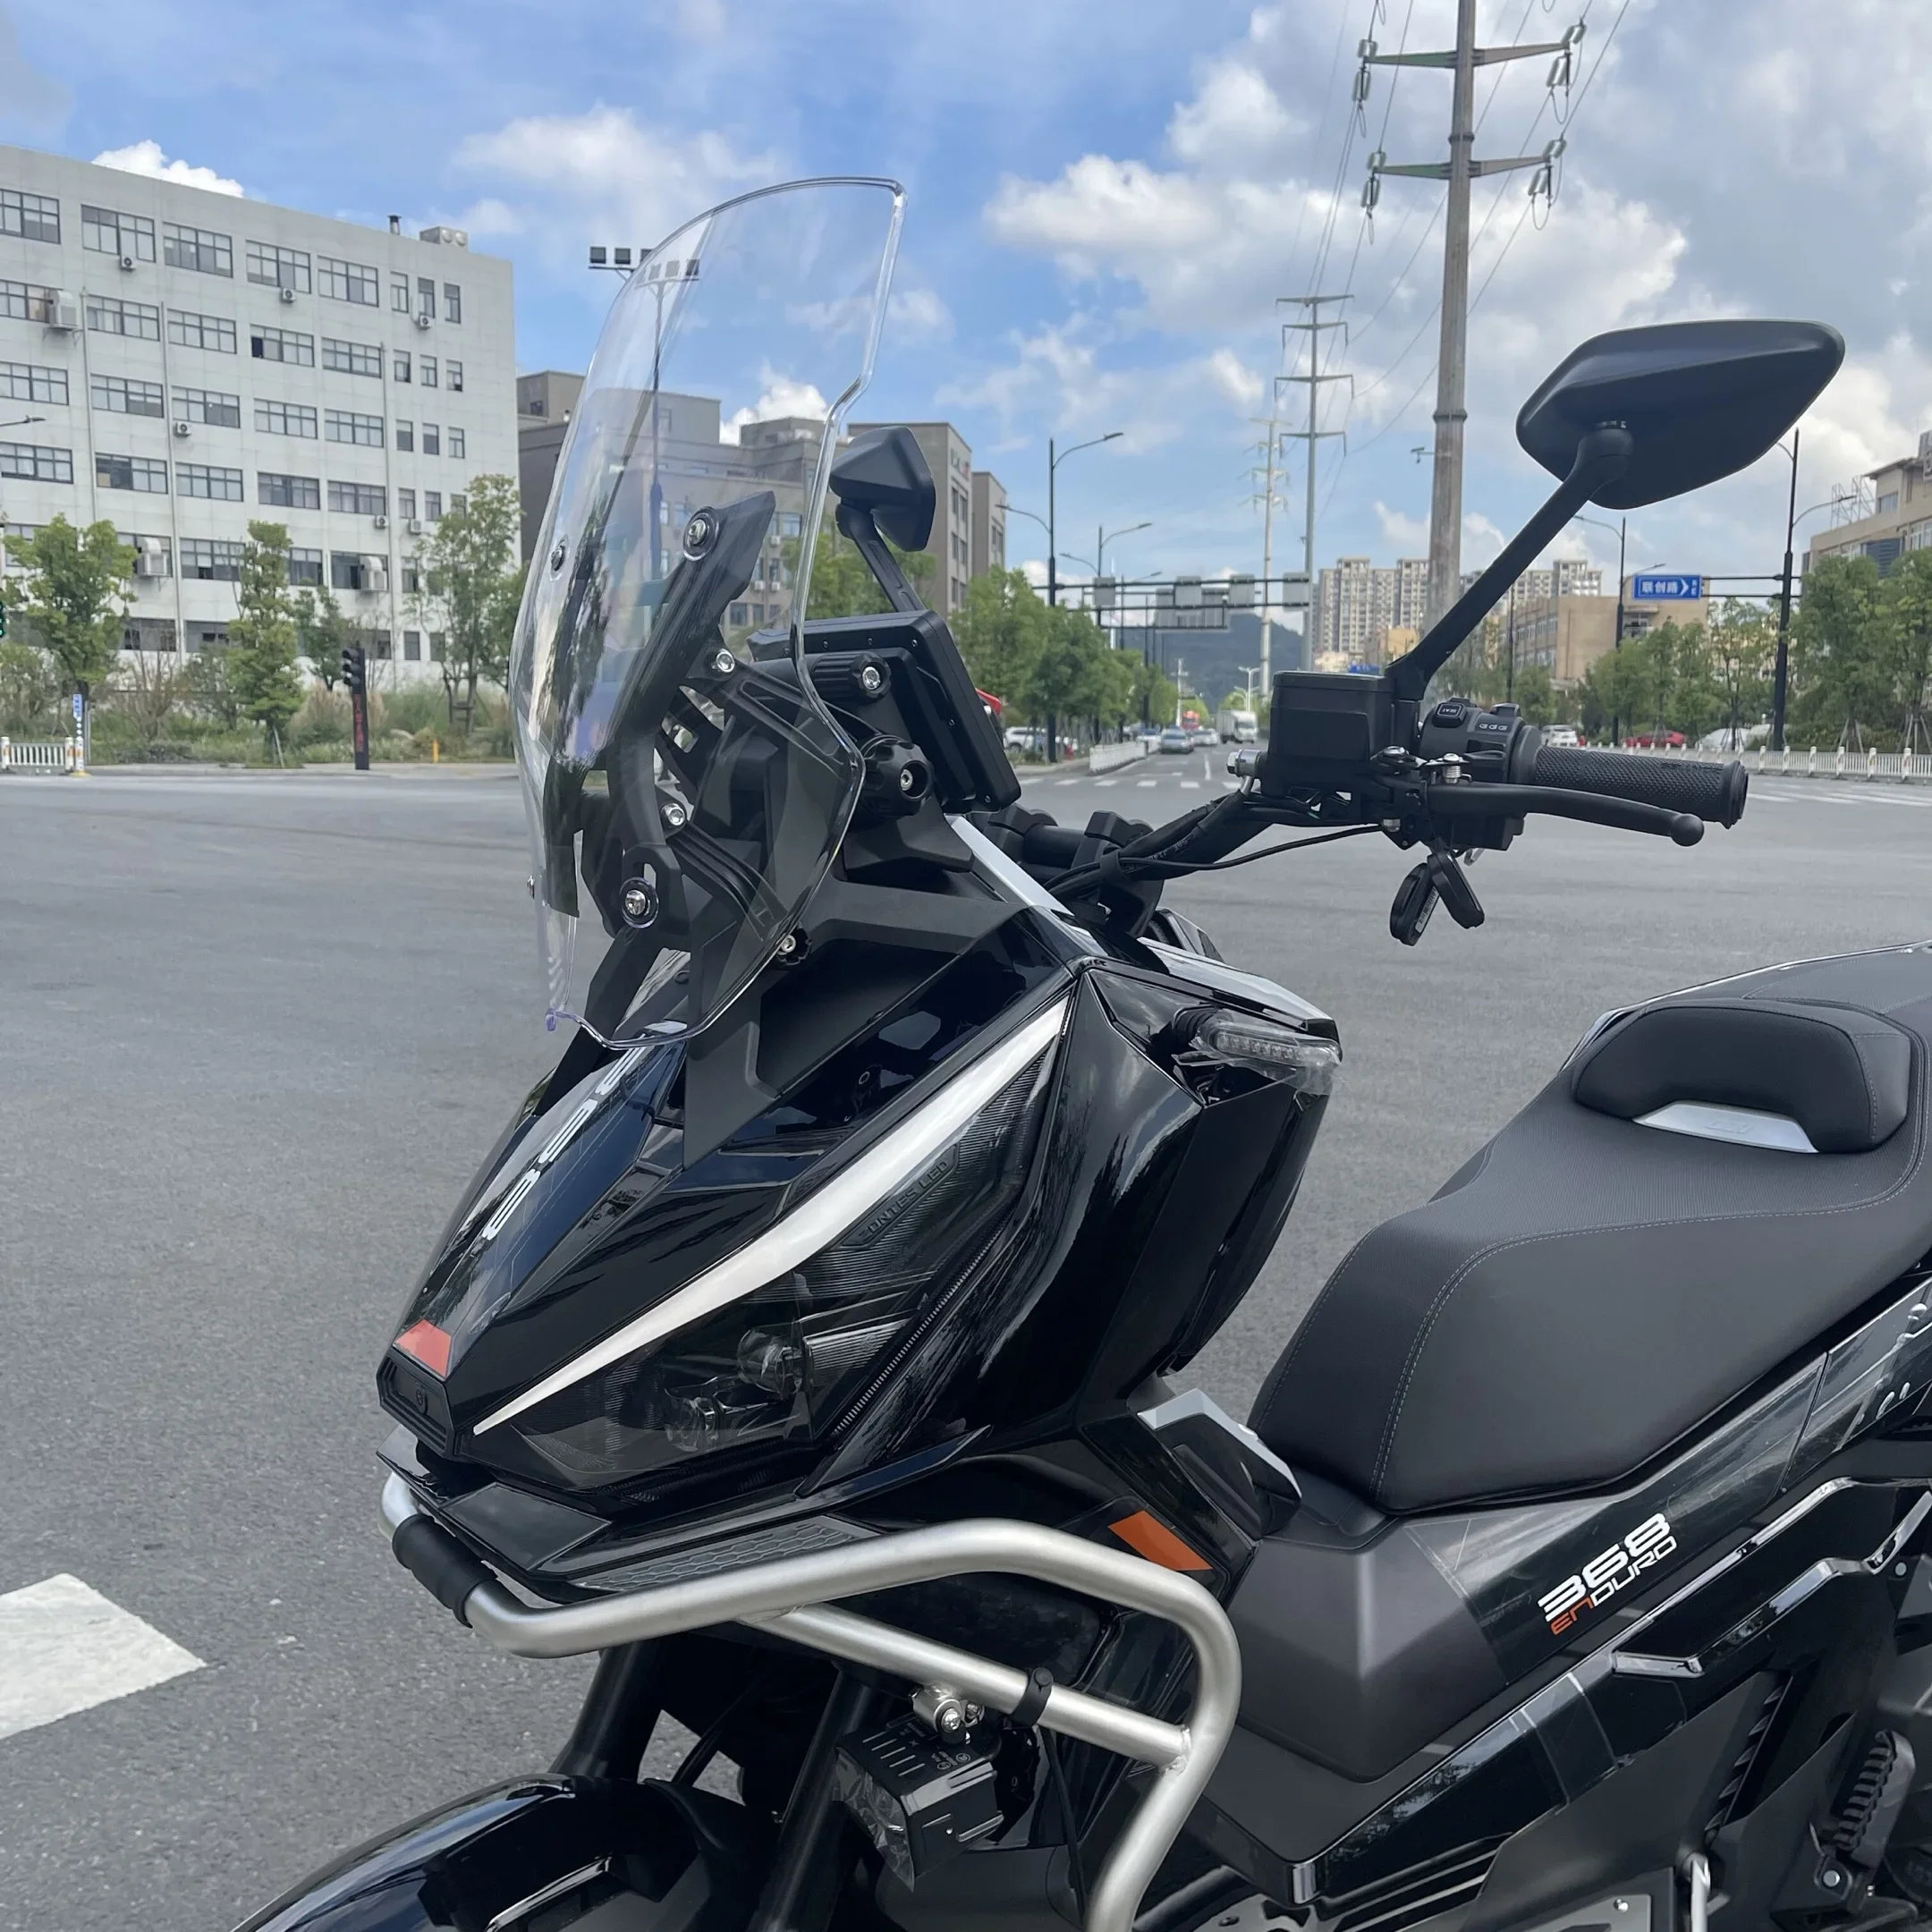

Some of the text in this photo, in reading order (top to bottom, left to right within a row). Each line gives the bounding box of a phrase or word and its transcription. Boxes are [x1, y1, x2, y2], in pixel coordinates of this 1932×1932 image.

[859, 1161, 947, 1240] ZONTES LED
[1538, 1513, 1671, 1623] 368
